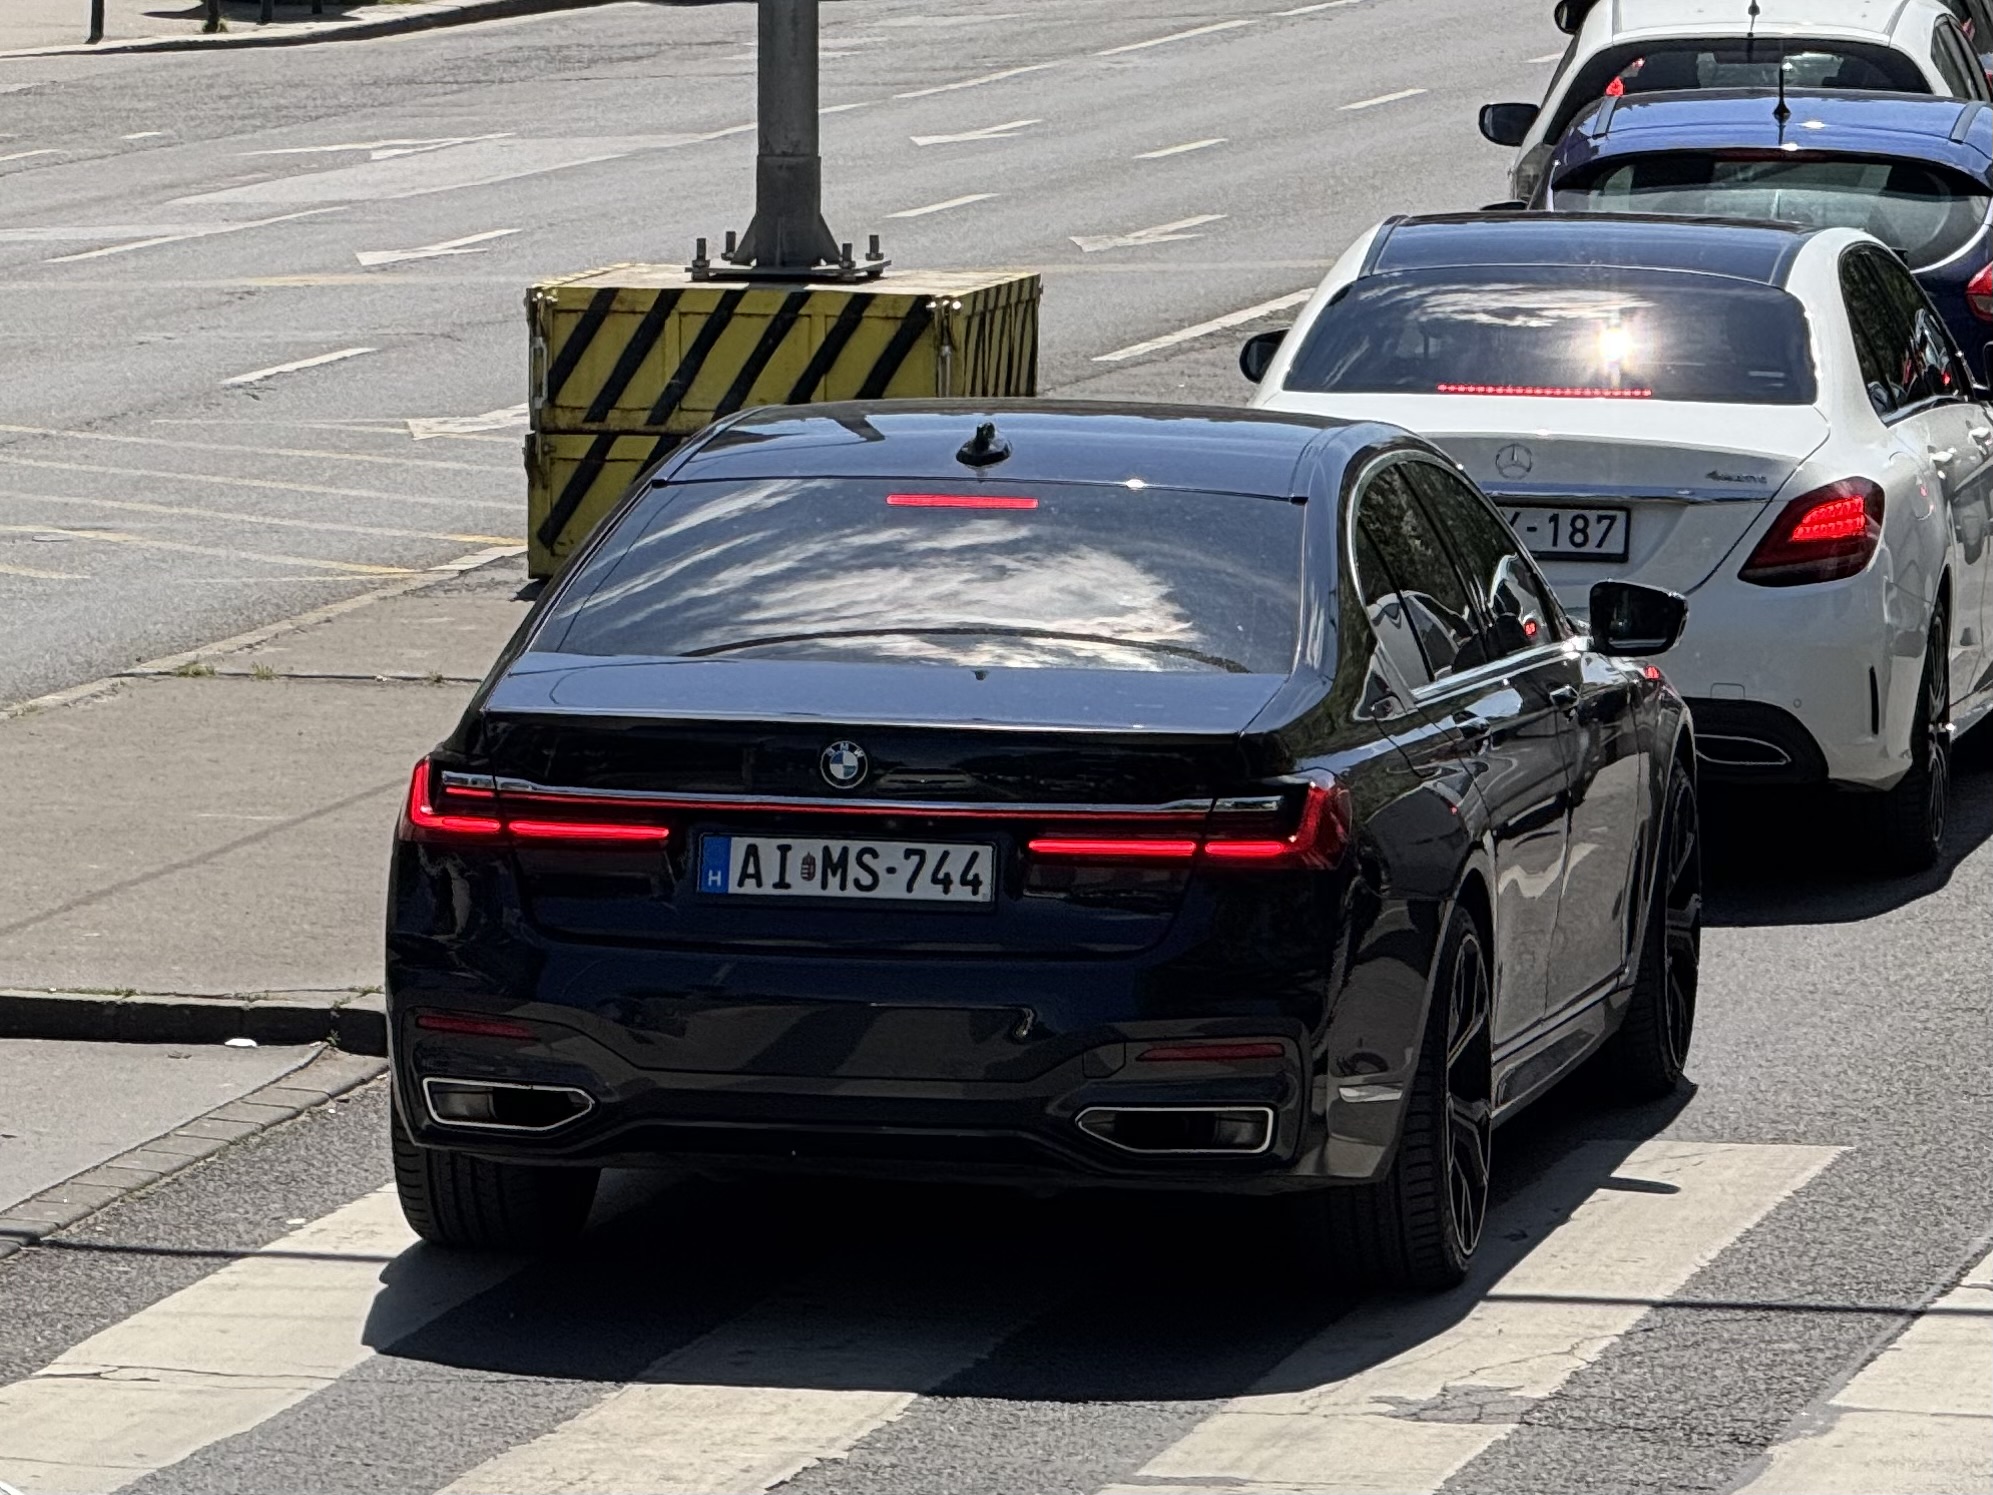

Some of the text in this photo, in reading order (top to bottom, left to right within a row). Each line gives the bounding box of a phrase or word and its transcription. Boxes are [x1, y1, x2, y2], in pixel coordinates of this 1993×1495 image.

[708, 869, 721, 887] H
[737, 843, 983, 896] AI MS-744
